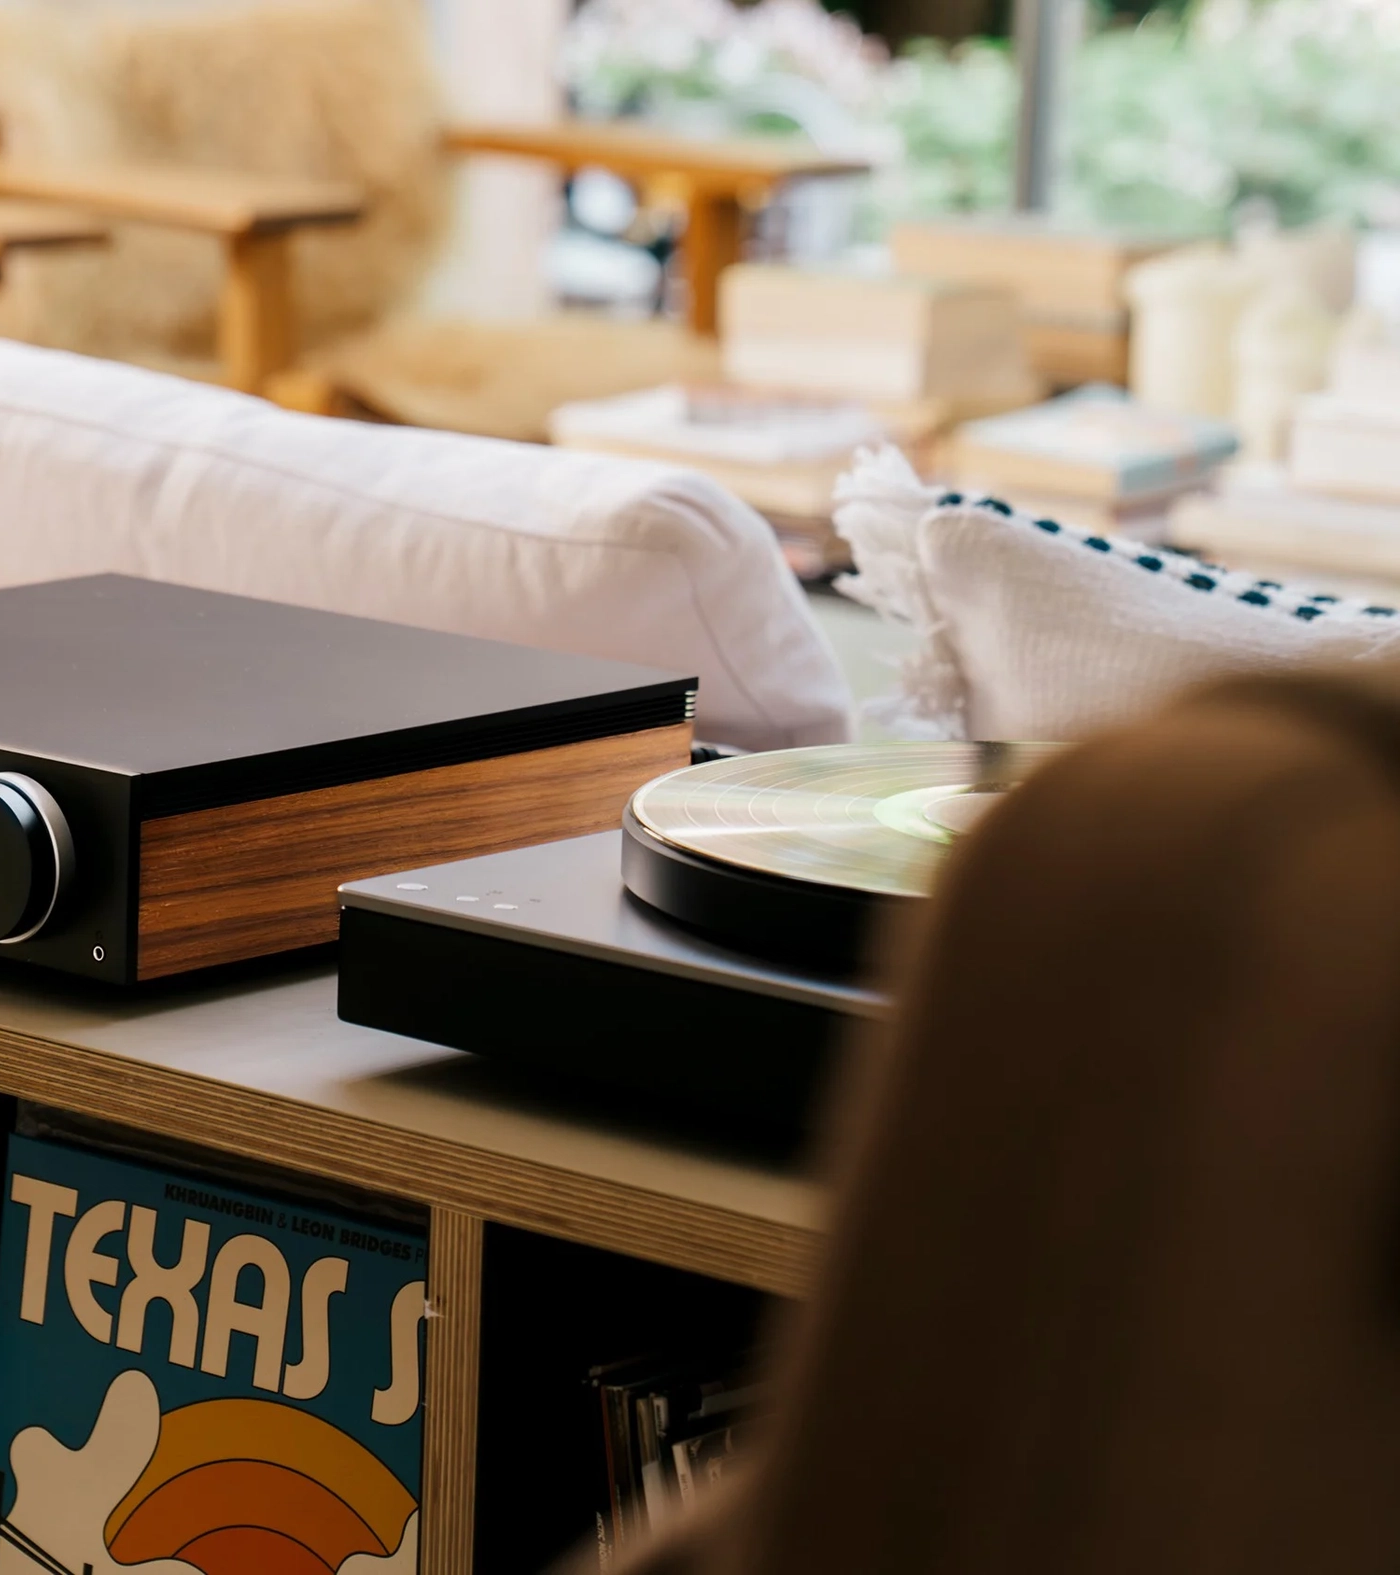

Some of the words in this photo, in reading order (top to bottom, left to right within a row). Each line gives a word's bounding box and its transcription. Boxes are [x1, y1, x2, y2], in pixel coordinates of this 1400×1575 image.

[9, 1171, 351, 1401] TEXAS
[163, 1182, 274, 1227] KHRUANGBIN
[277, 1213, 287, 1229] &
[291, 1215, 336, 1242] LEON
[339, 1228, 412, 1262] BRIDGES
